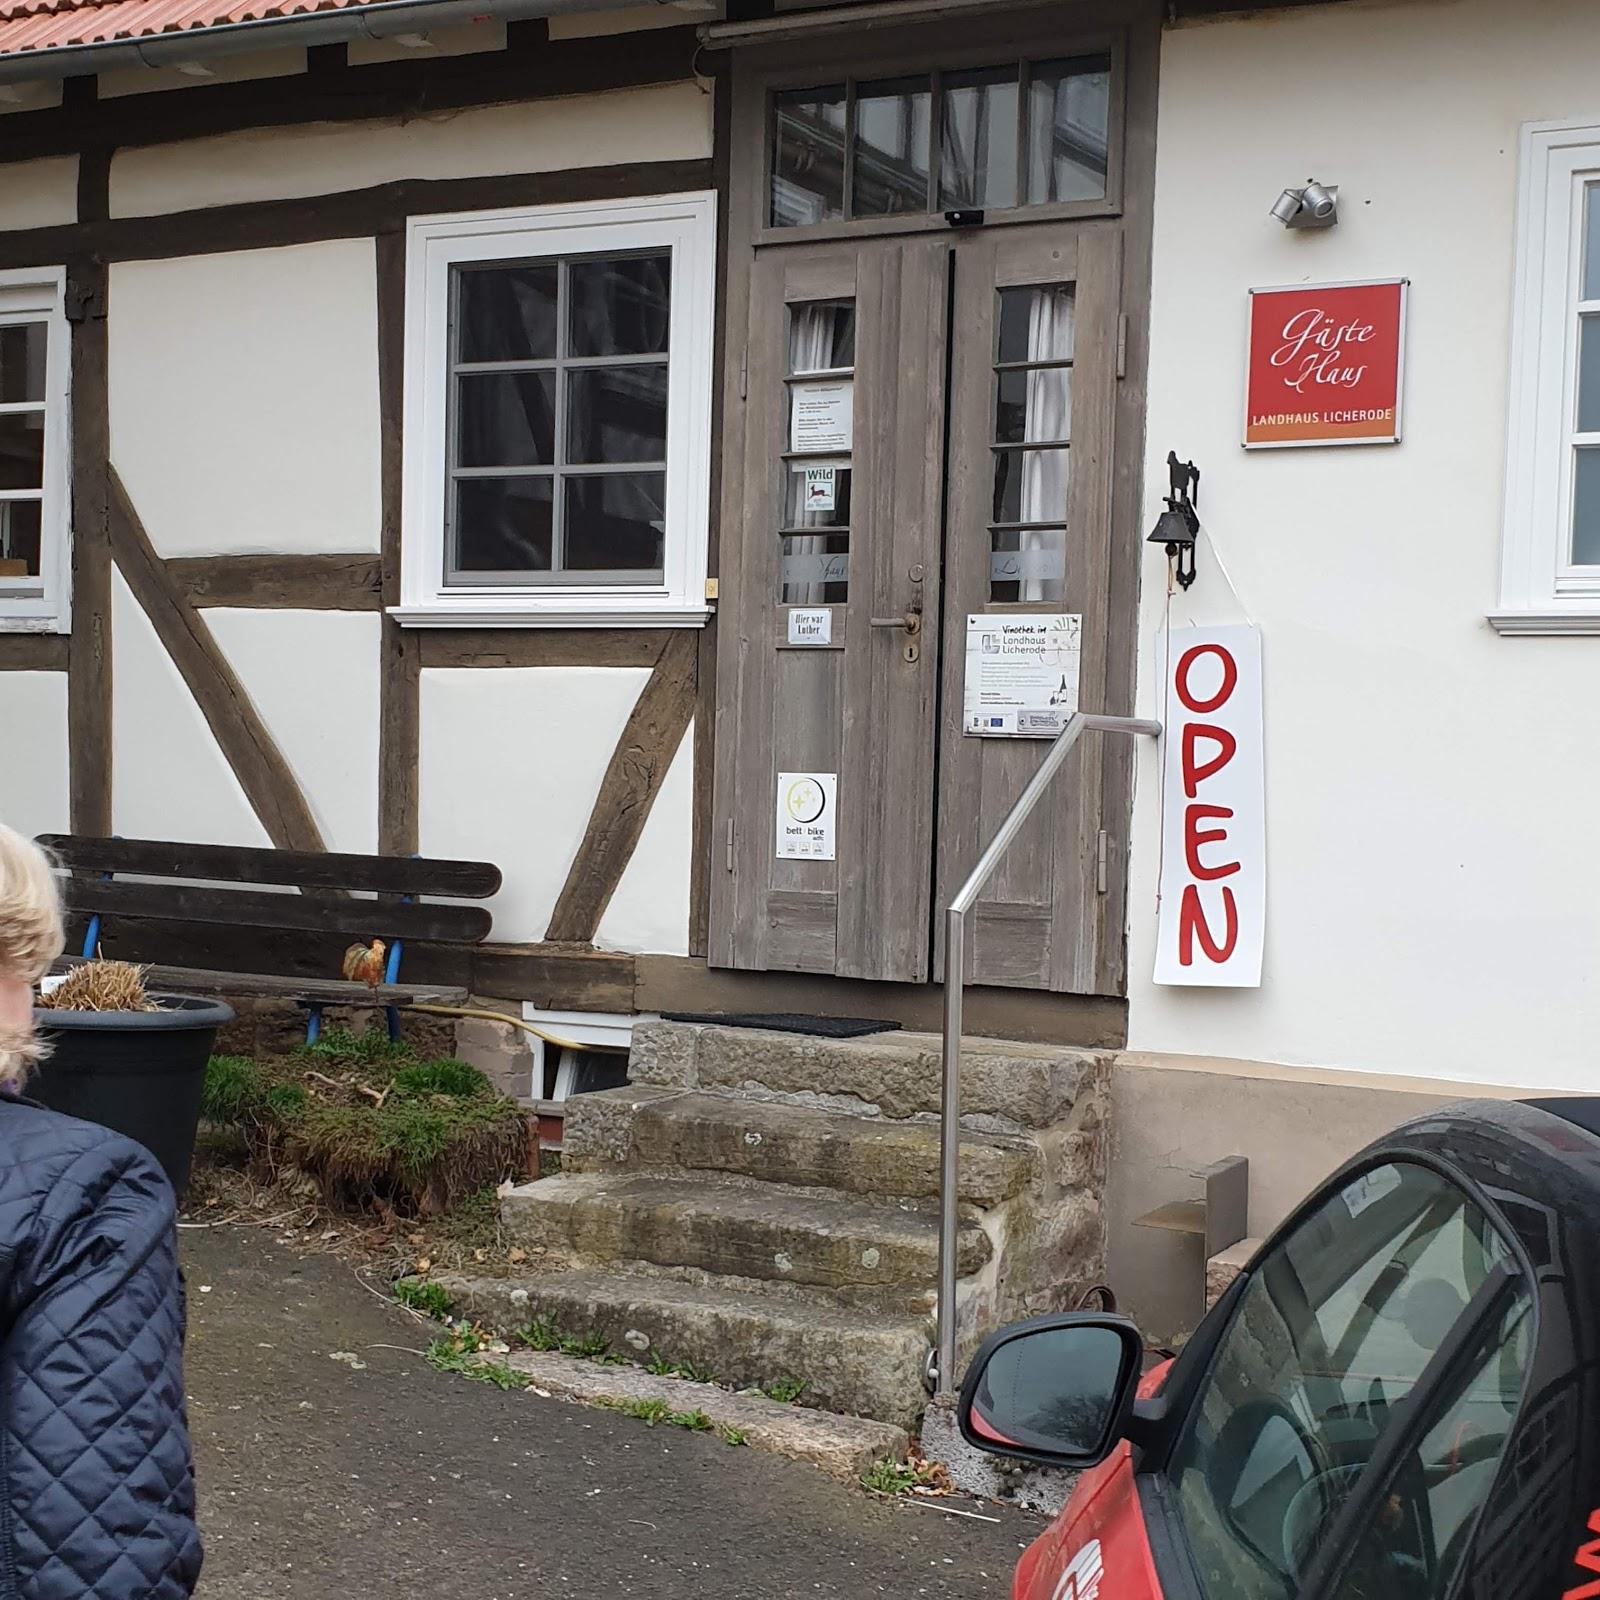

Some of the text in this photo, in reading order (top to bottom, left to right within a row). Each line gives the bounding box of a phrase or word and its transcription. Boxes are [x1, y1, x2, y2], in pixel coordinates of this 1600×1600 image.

[1270, 308, 1376, 366] Gäste
[1284, 350, 1368, 393] Haus
[1252, 408, 1392, 426] LANDHAUS LICHERODE
[807, 468, 833, 480] Wild
[796, 614, 810, 624] Hier
[798, 624, 821, 635] Luther
[1002, 625, 1035, 634] Vinothek
[1003, 635, 1046, 645] Landhaus
[1002, 645, 1046, 655] Licherode
[1175, 643, 1241, 967] OPEN
[786, 826, 824, 835] bett bike
